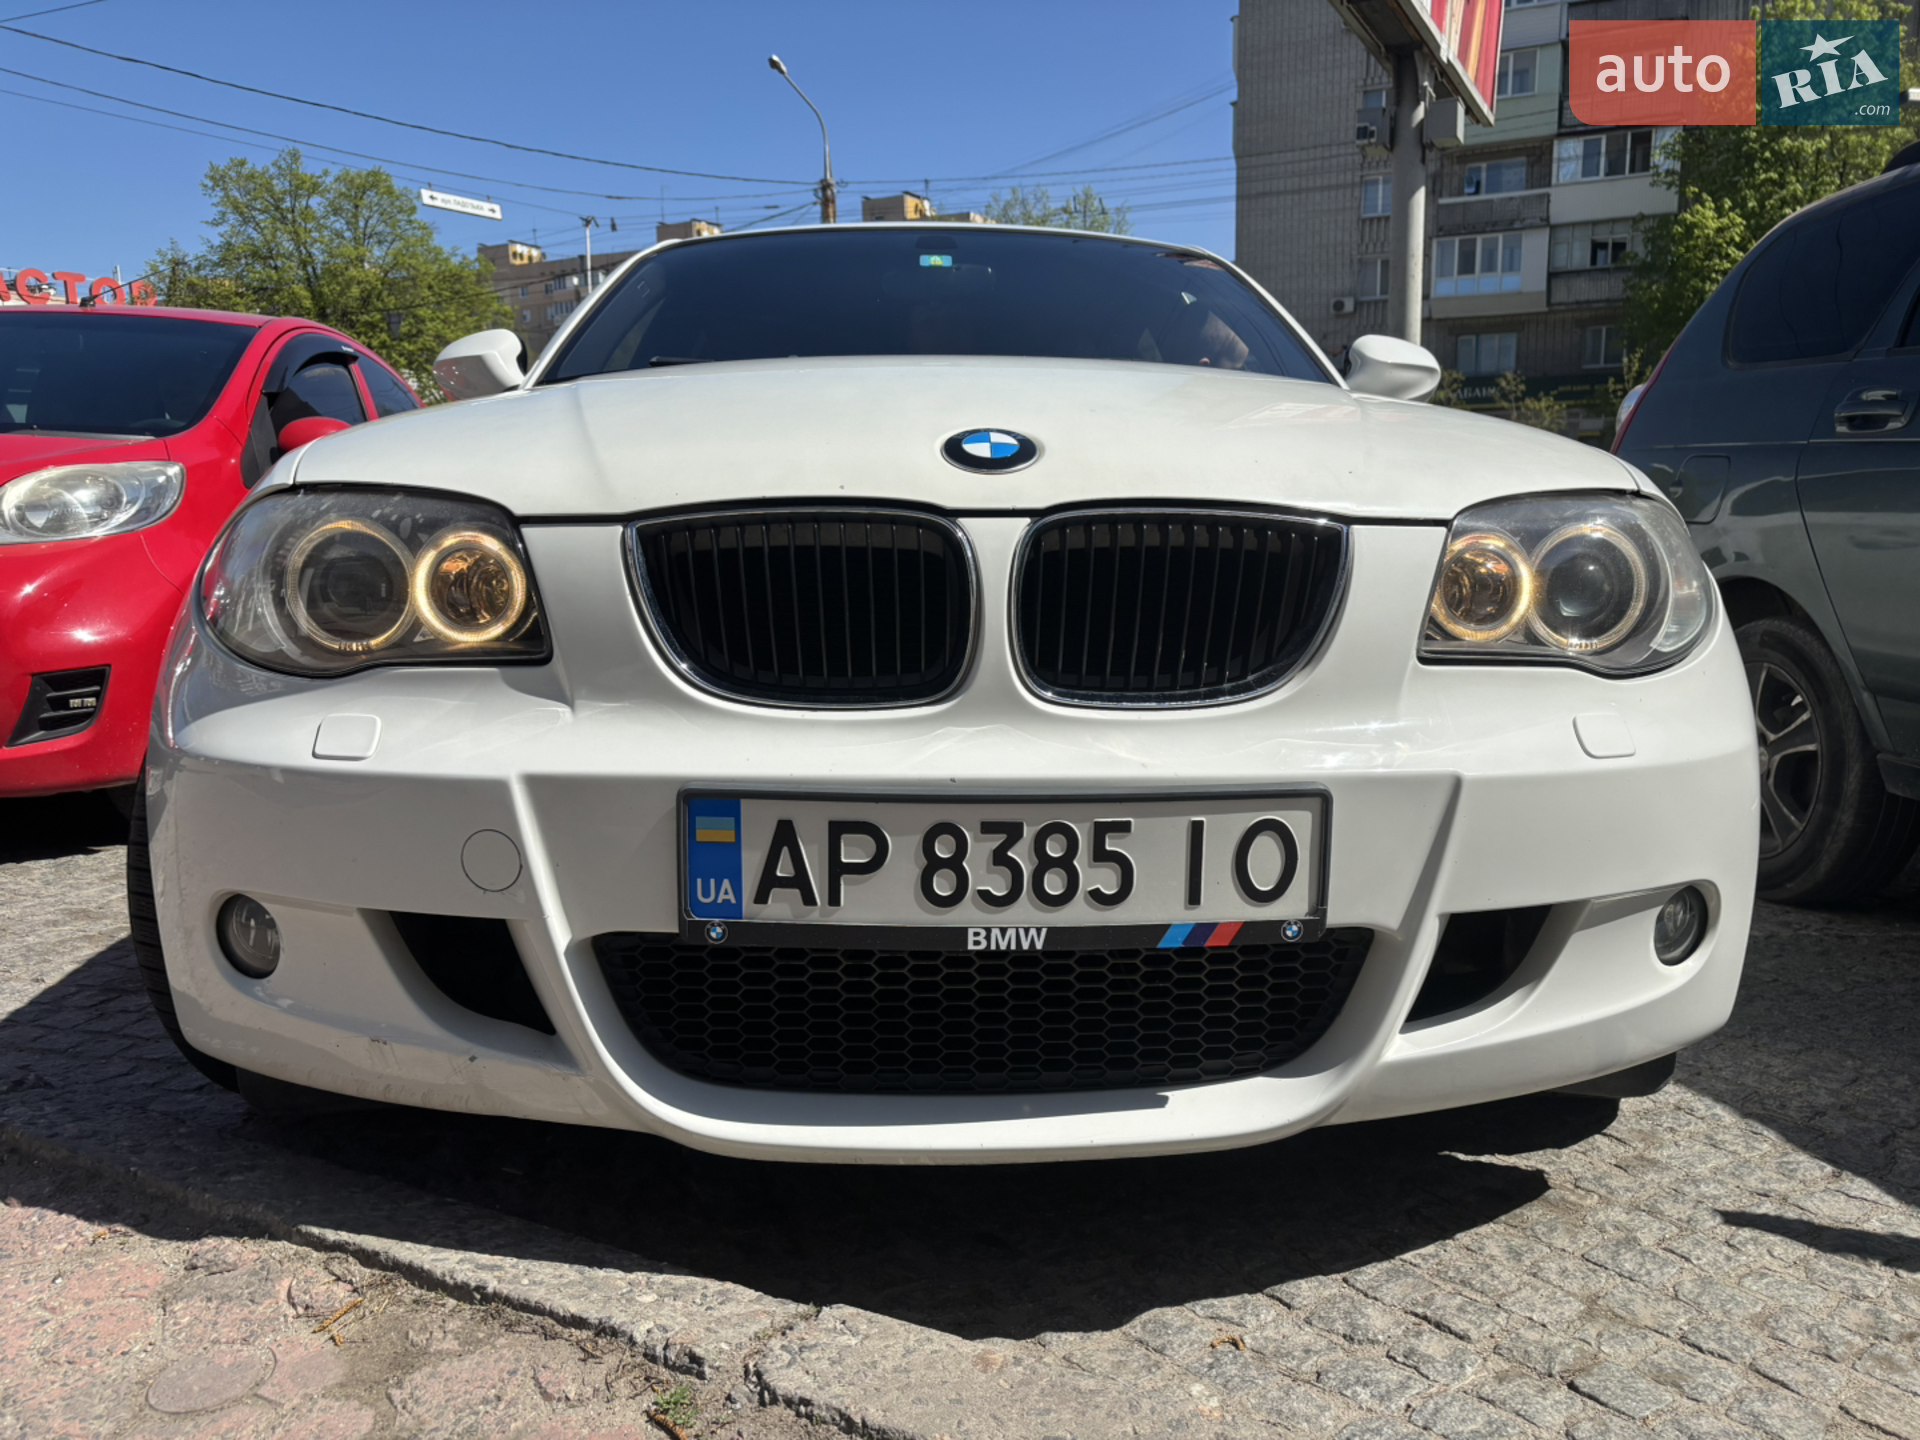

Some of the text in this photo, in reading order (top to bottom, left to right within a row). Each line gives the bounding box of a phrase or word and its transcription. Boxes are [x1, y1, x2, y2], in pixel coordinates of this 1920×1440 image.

[753, 819, 892, 907] AP
[919, 818, 1136, 908] 8385
[696, 878, 737, 904] UA
[967, 927, 1048, 950] BMW
